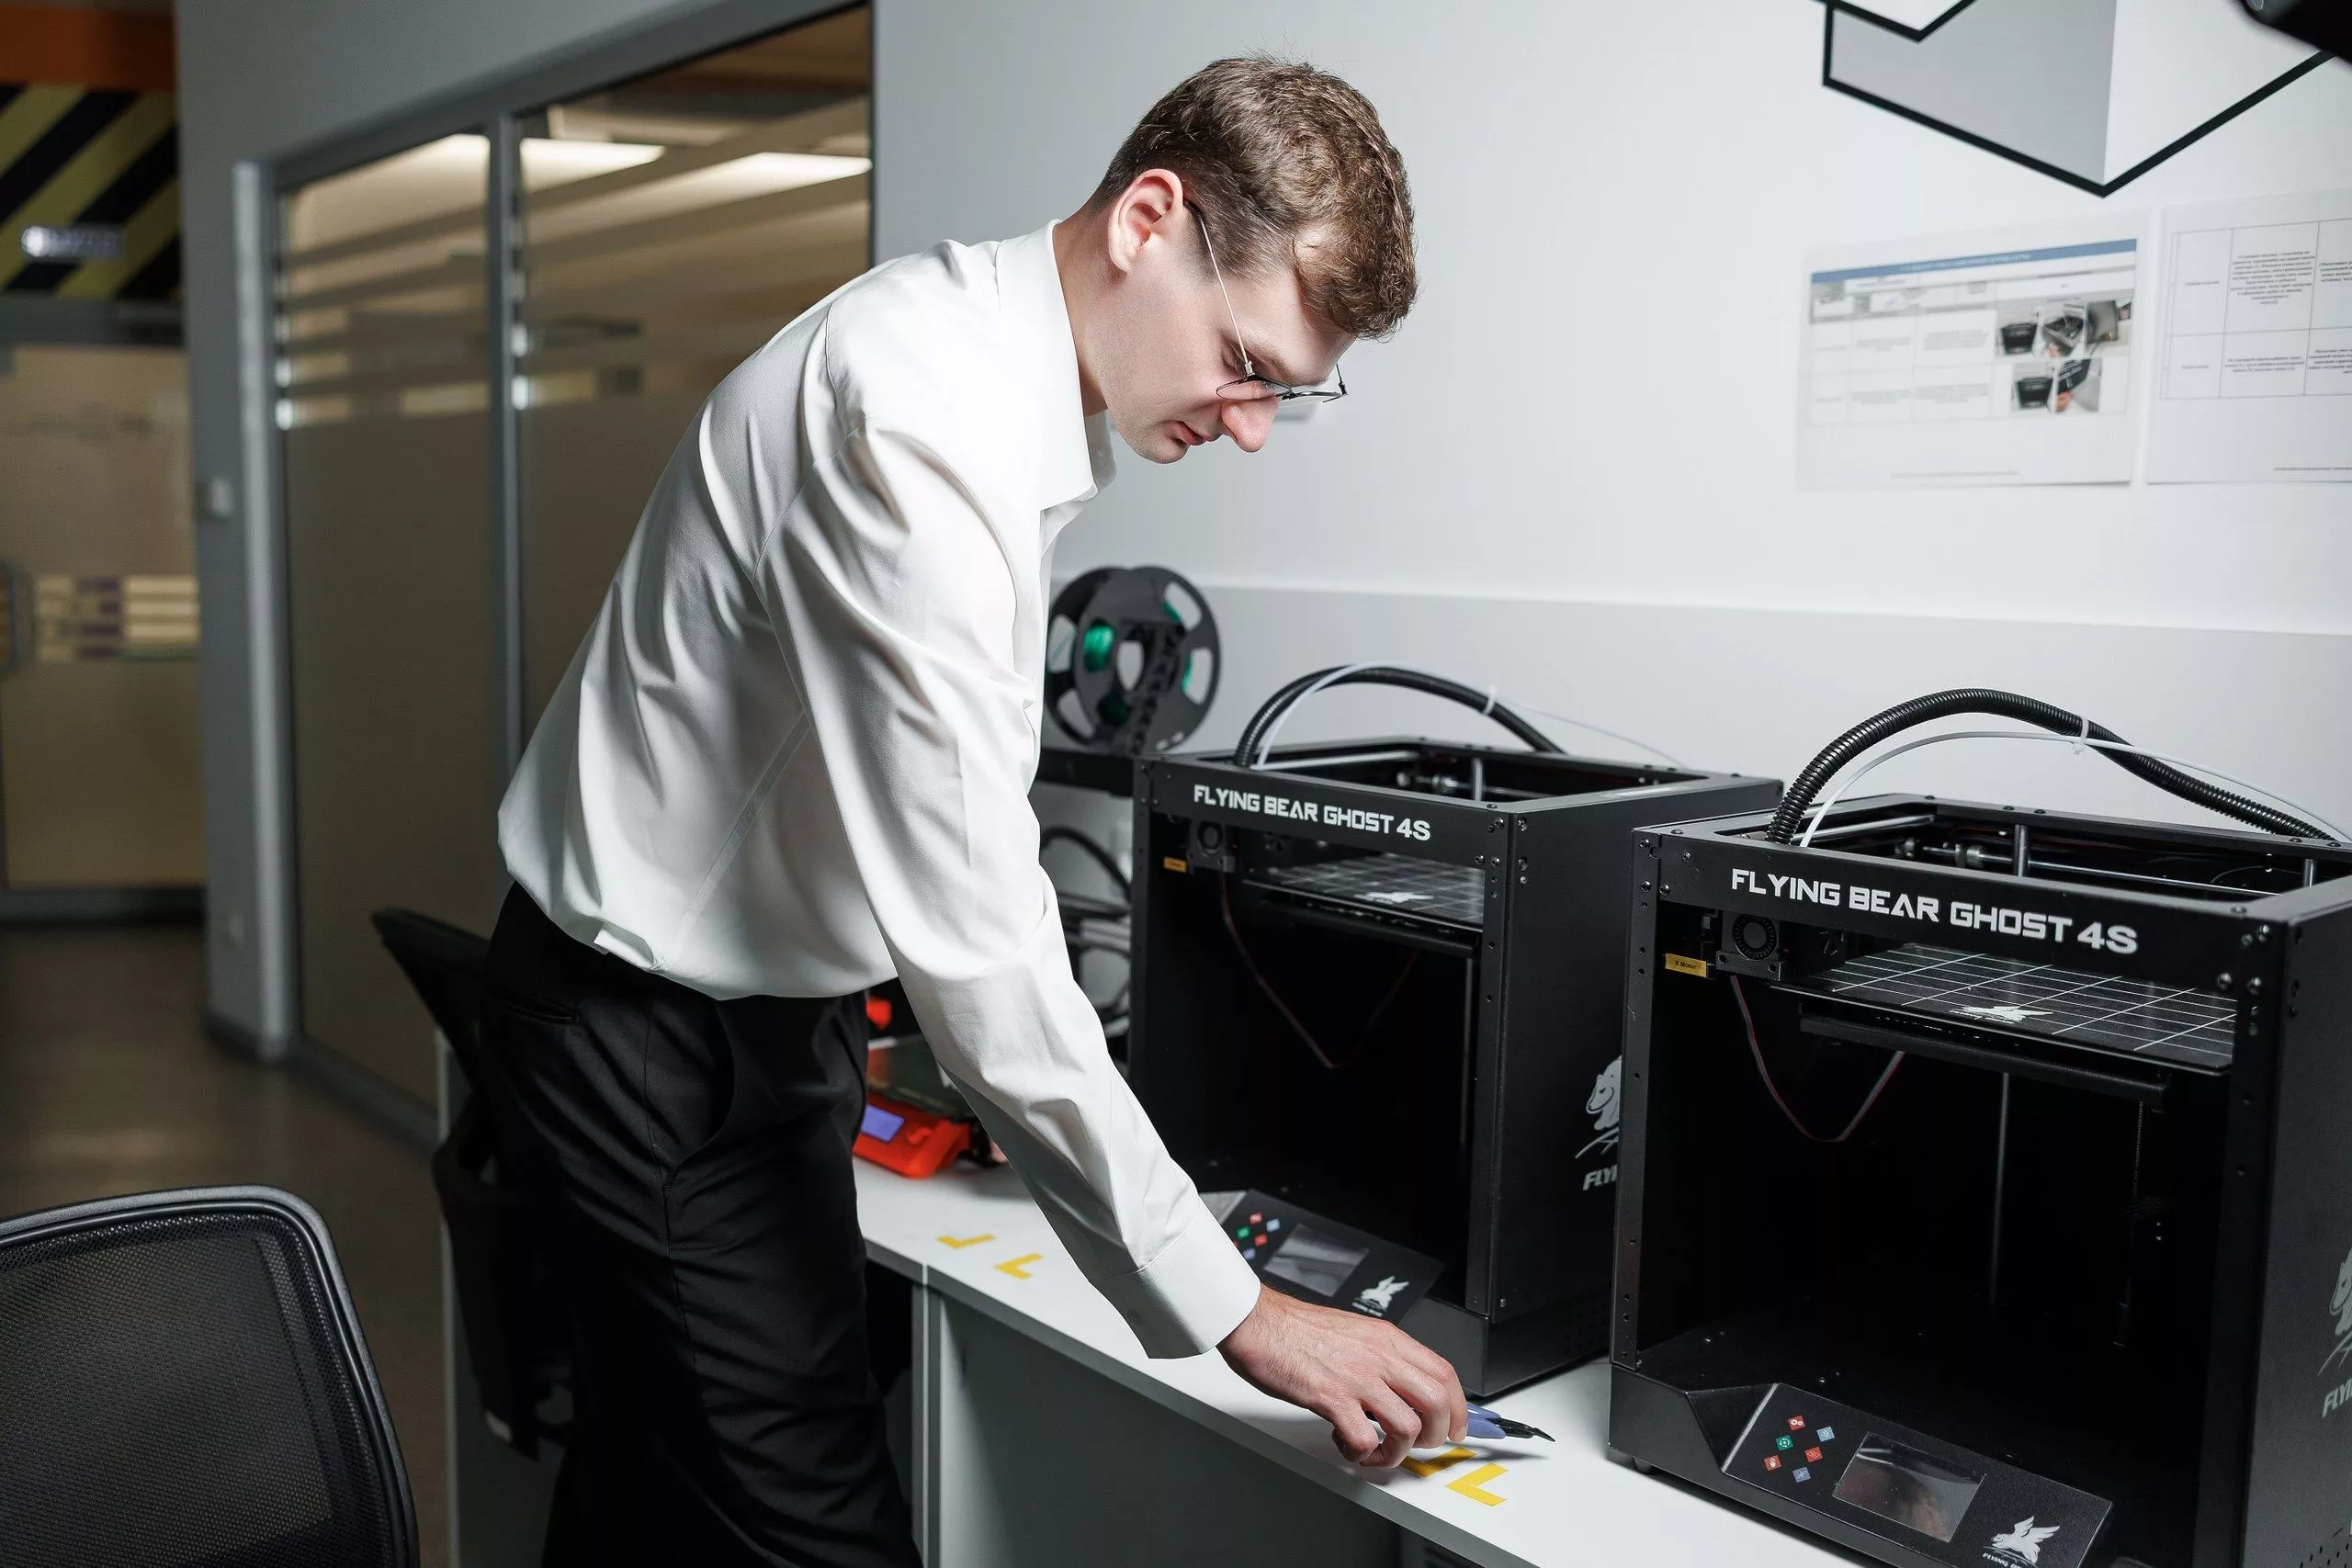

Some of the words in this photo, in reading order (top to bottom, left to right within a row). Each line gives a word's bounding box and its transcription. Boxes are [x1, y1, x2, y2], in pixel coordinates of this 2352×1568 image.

[1193, 784, 1261, 813] FLYING
[1263, 795, 1318, 823] BEAR
[1323, 805, 1395, 834] GHOST
[1396, 818, 1431, 841] 4S
[1731, 868, 1841, 907] FLYING
[1849, 886, 1939, 923] BEAR
[1950, 901, 2073, 942] GHOST
[2077, 921, 2137, 953] 4S
[1680, 961, 1697, 970] Motor
